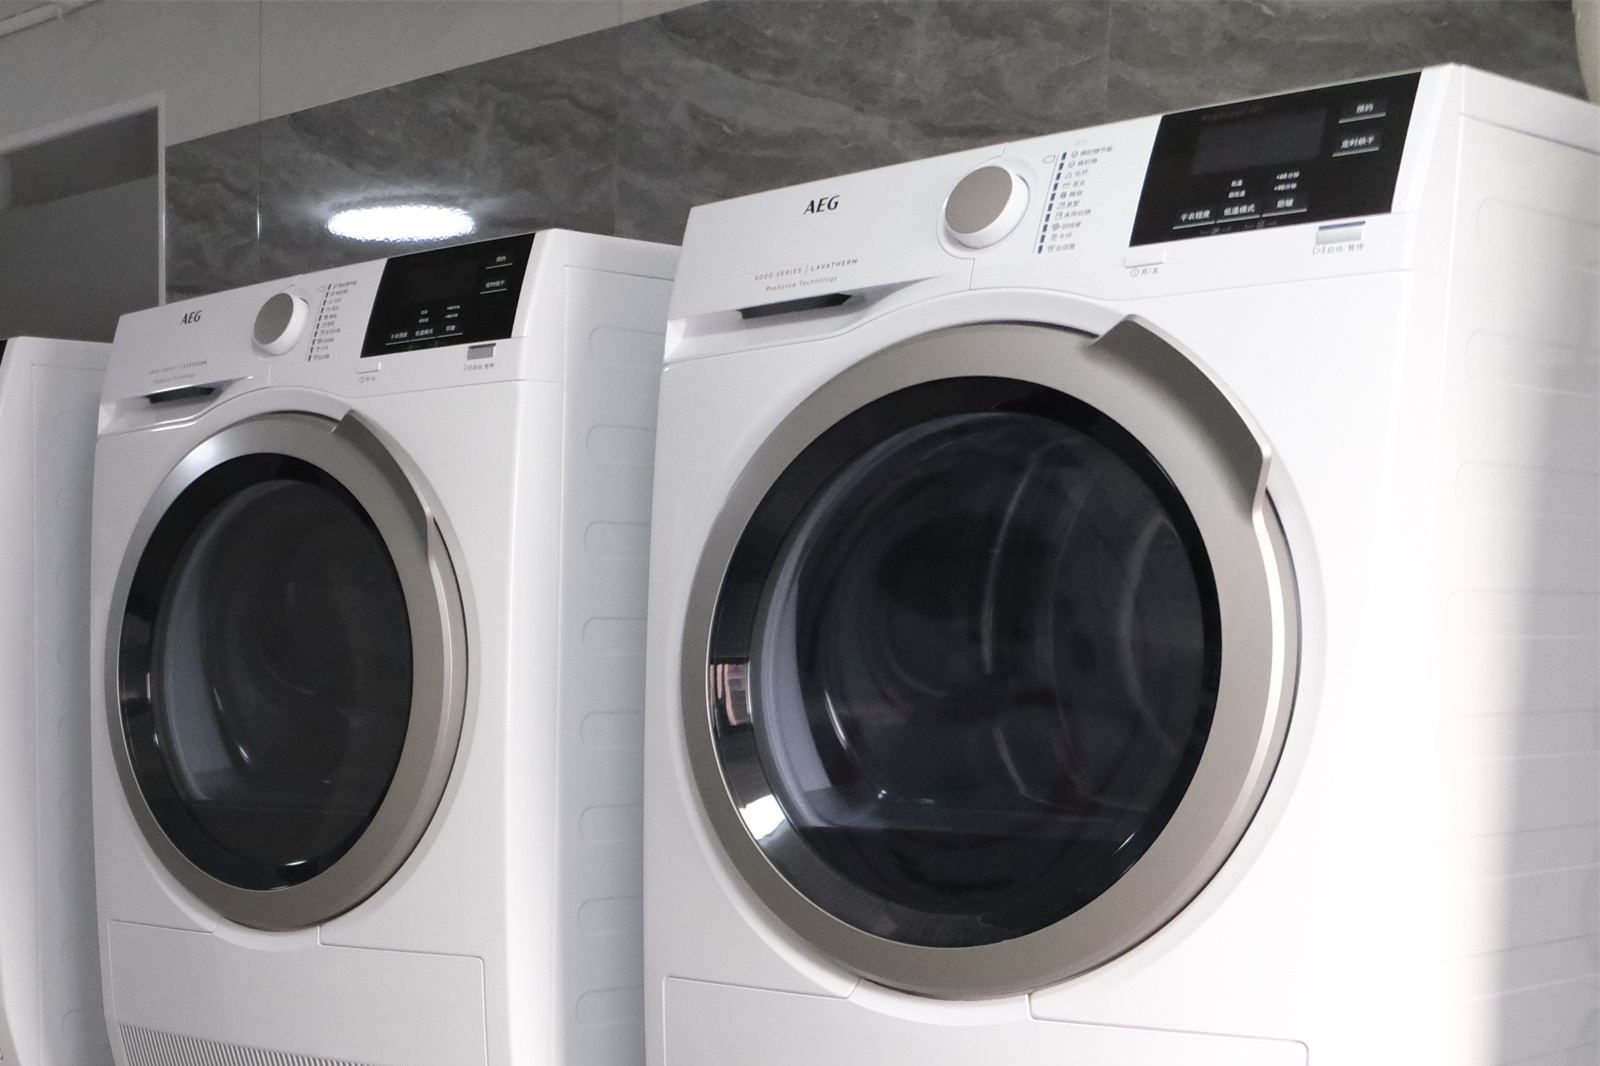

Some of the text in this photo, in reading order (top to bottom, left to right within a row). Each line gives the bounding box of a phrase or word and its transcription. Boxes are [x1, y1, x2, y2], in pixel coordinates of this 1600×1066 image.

[803, 195, 840, 215] AEG
[754, 259, 858, 281] 6000 SERIES LAVATHERM
[765, 276, 838, 292] ProSense Technology
[180, 310, 202, 325] AEG
